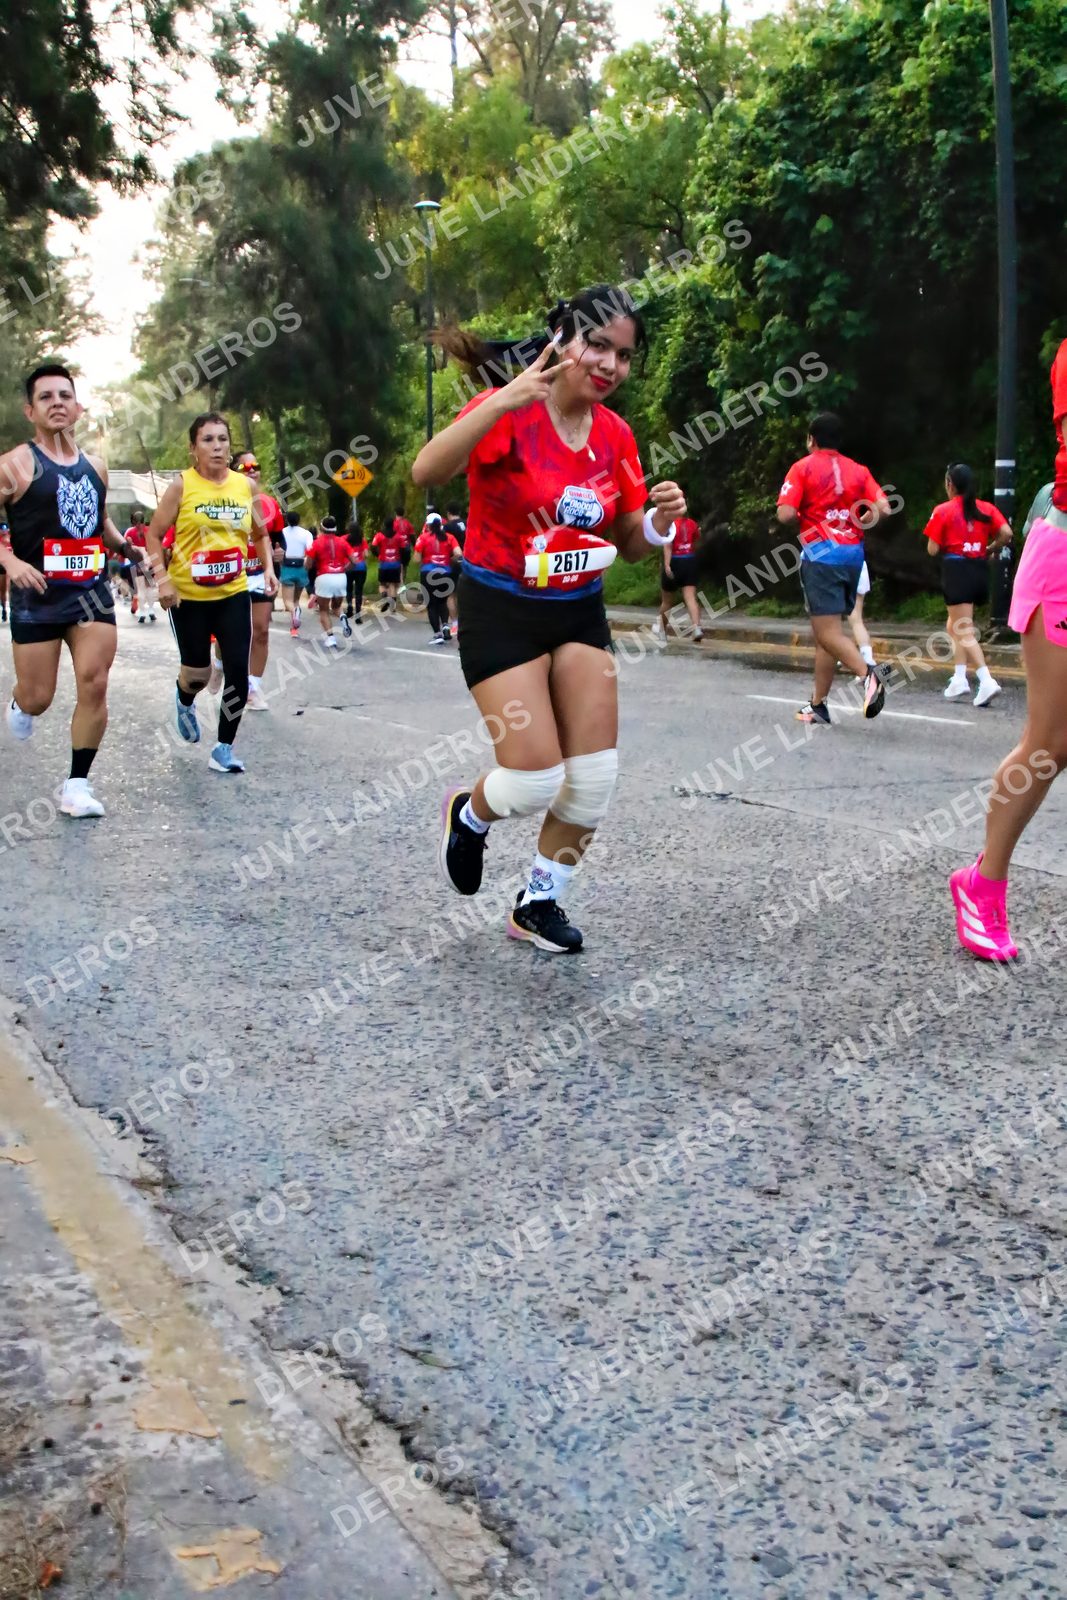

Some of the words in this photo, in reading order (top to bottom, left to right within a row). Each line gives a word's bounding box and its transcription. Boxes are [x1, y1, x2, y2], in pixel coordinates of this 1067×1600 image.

[65, 556, 89, 569] 1637
[208, 562, 230, 575] 3328
[553, 551, 589, 573] 2617
